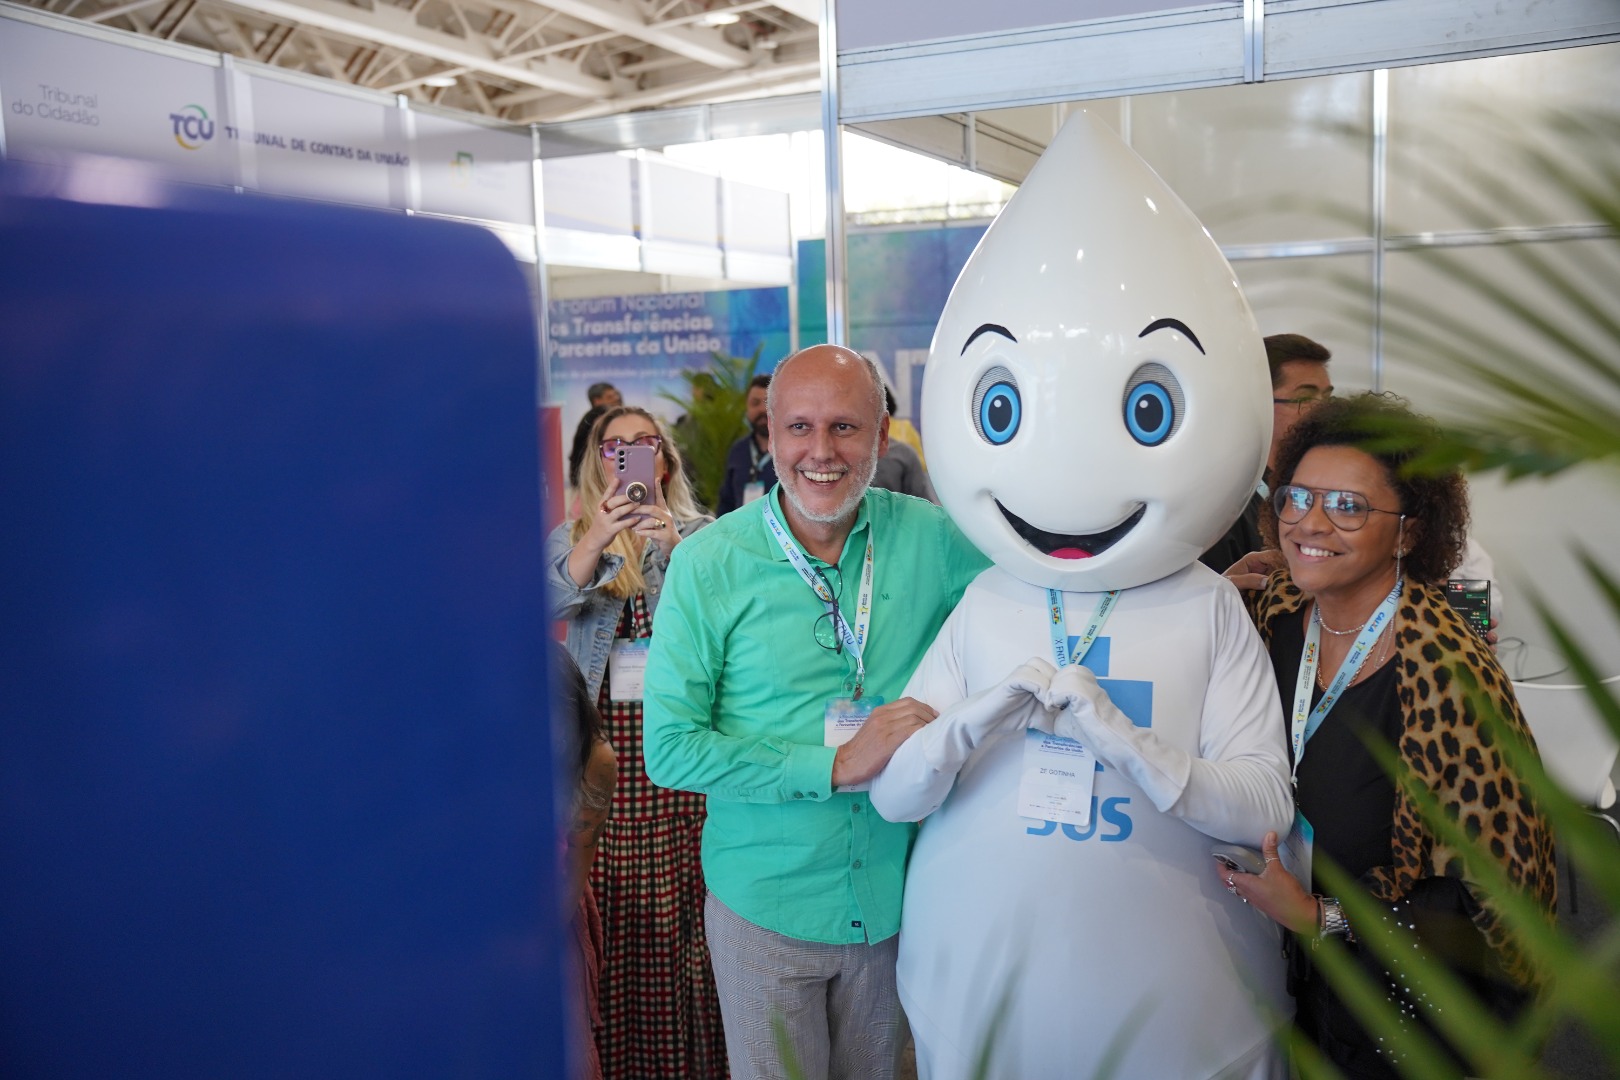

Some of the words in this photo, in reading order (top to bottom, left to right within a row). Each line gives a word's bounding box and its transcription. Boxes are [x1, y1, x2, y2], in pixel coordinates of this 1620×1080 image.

[39, 84, 98, 108] Tribunal
[12, 99, 34, 116] do
[37, 102, 100, 127] Cidadão
[169, 113, 214, 140] TCU
[291, 137, 306, 152] DE
[310, 141, 353, 160] CONTAS
[357, 149, 372, 163] DA
[572, 312, 713, 336] Transferências
[636, 335, 661, 355] da
[663, 333, 720, 354] União
[1368, 612, 1385, 633] CAIXA
